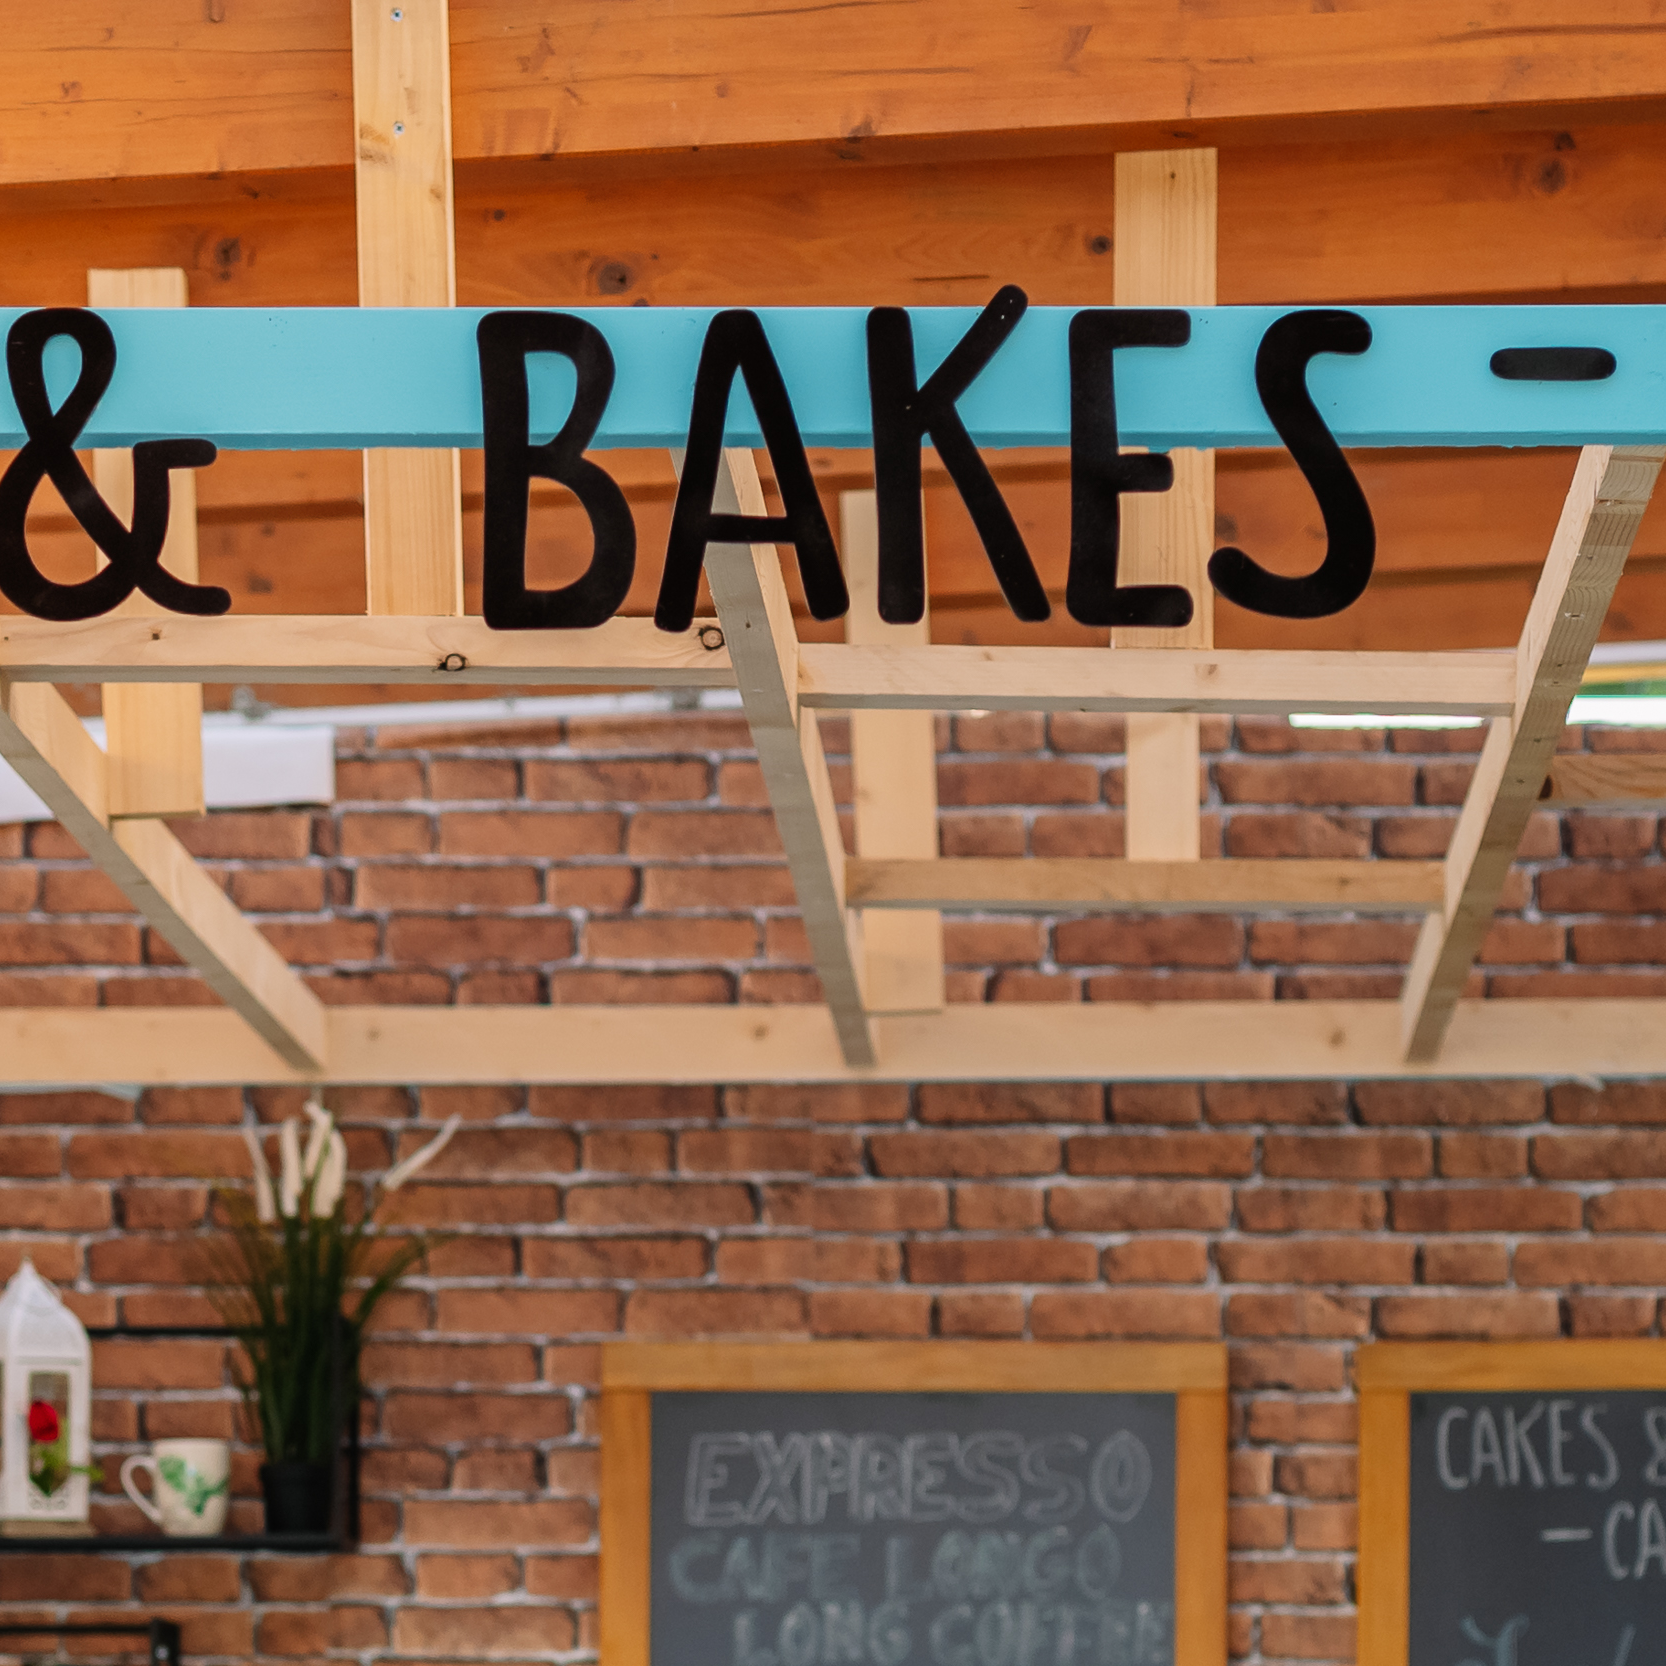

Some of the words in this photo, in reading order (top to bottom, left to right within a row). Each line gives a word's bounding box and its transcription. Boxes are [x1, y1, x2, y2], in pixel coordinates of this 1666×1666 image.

[478, 285, 1375, 632] BAKES
[684, 1429, 1153, 1527] EXPRESSO
[1437, 1400, 1620, 1490] CAKES
